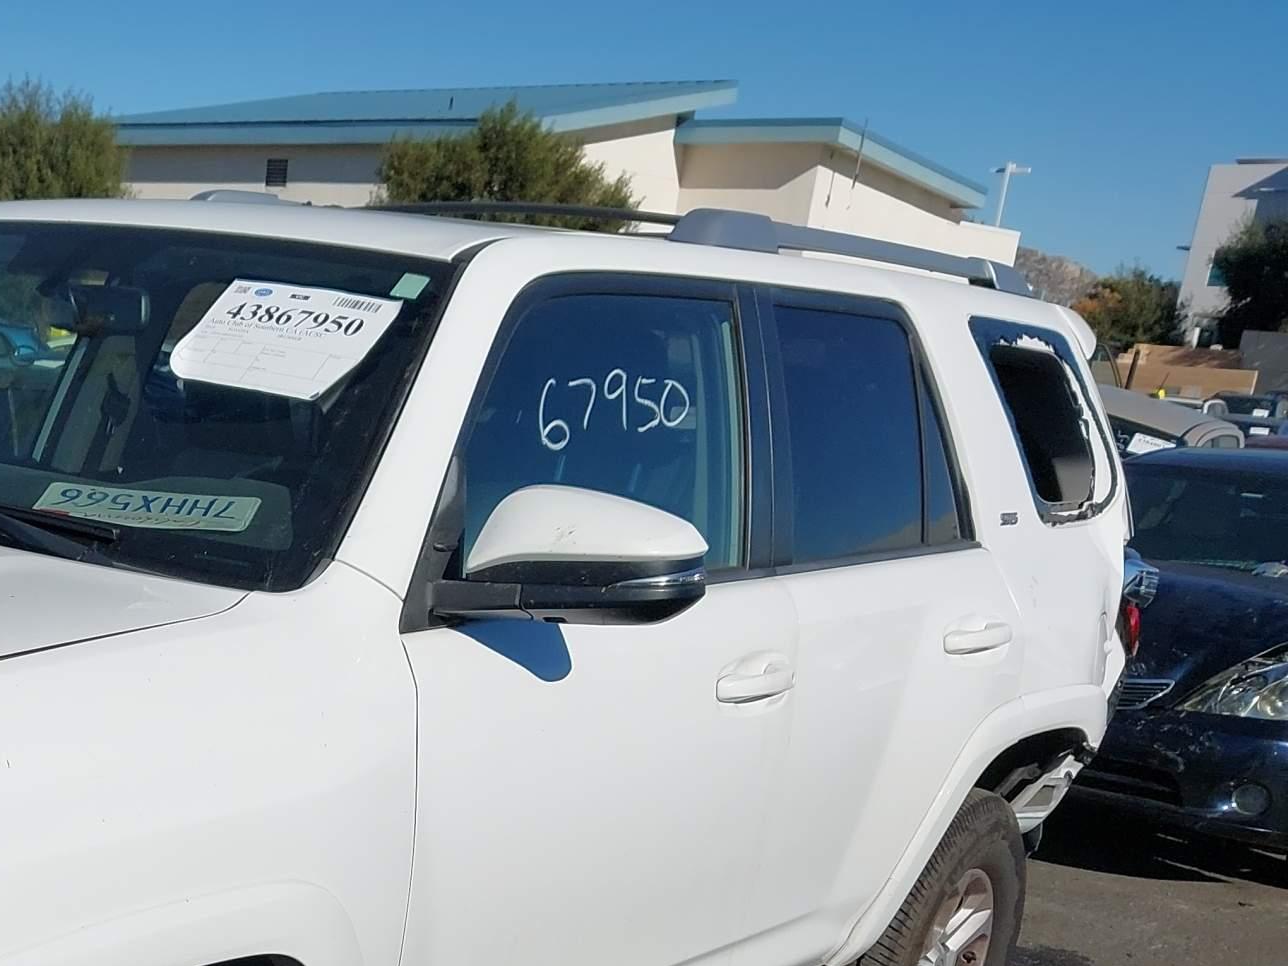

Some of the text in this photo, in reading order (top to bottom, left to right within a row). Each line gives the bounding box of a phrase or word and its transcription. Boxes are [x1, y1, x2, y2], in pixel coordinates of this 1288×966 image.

[226, 302, 365, 336] 43867950
[539, 369, 689, 450] 67950
[51, 488, 236, 520] 7HHX566
